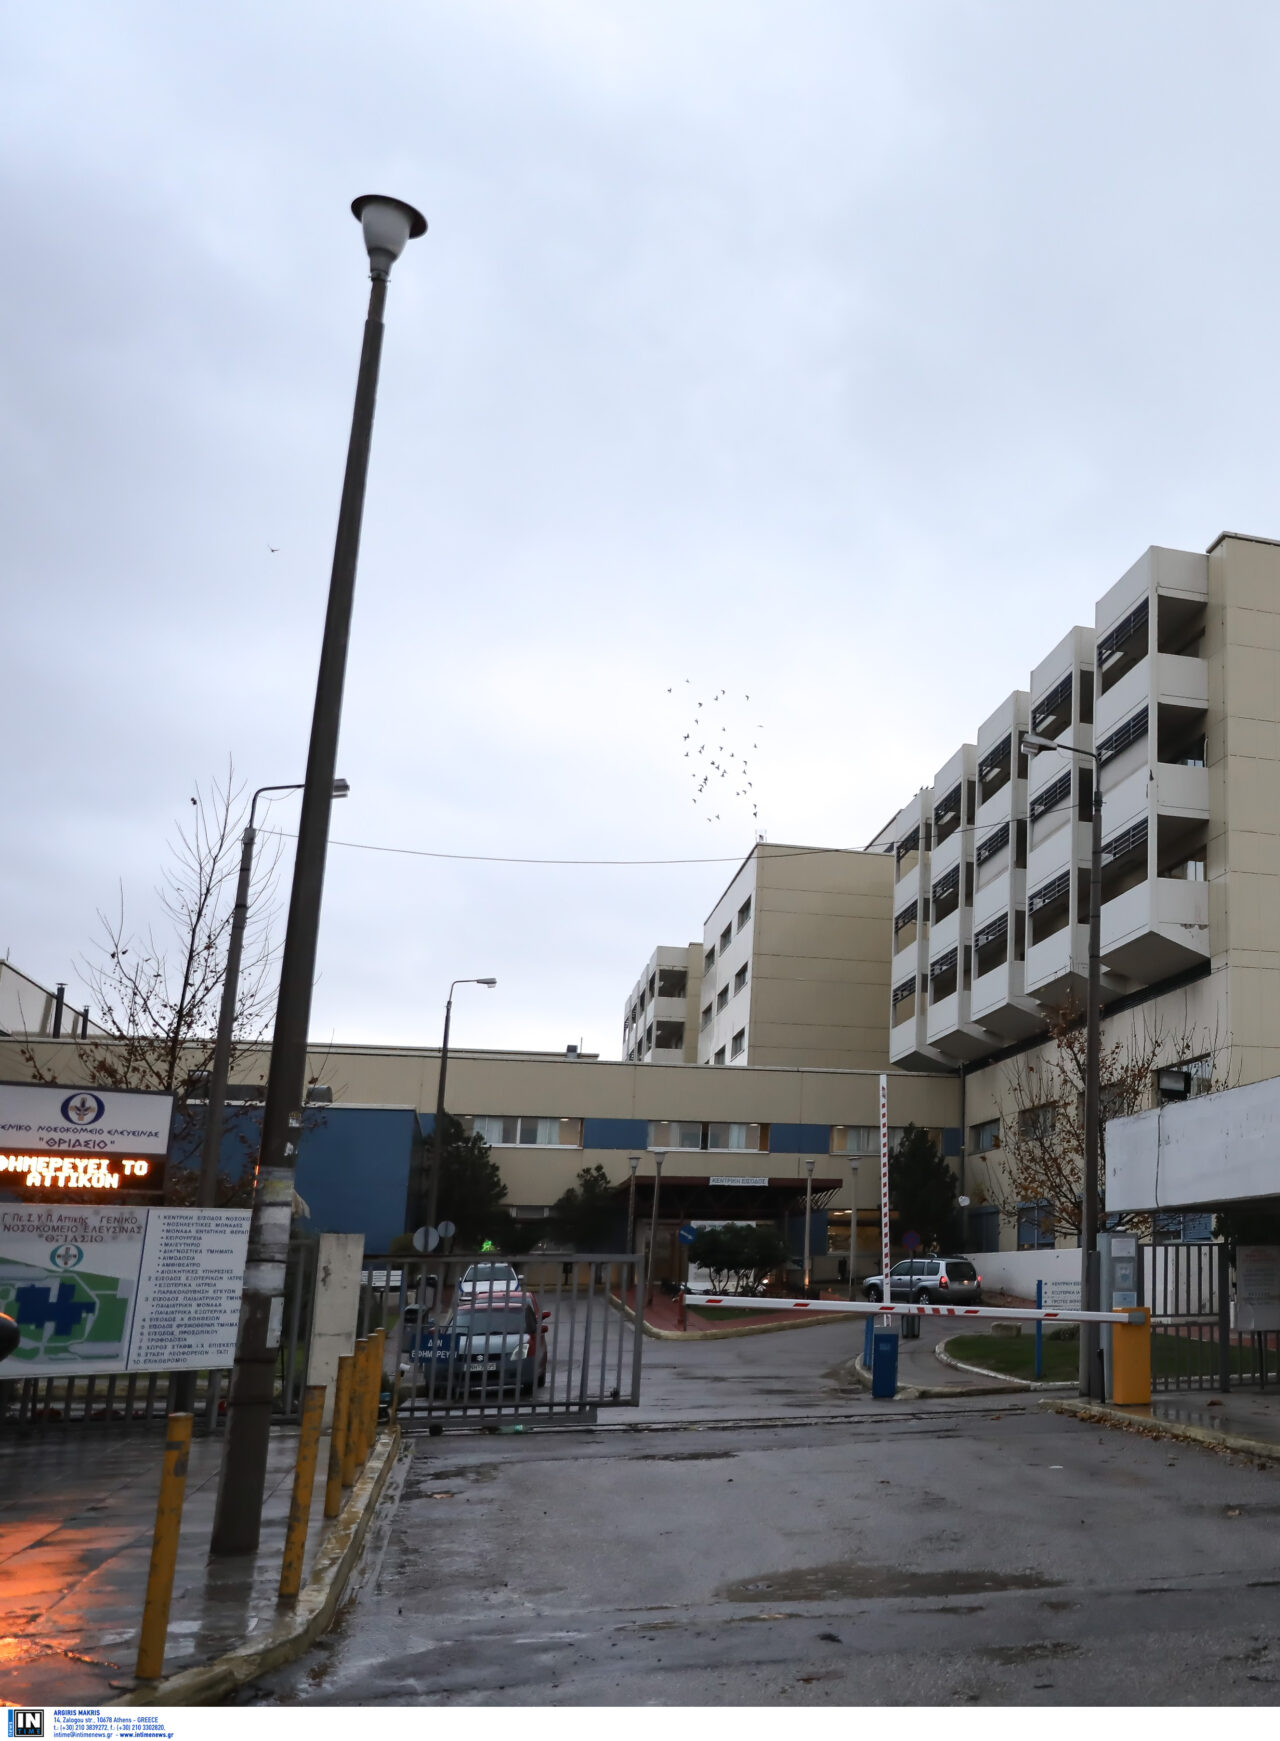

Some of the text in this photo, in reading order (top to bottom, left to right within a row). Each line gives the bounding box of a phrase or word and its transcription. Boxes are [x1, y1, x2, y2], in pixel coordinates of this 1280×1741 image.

[37, 1125, 104, 1135] ΝΟΣΟΚΟΜΕΙΟ
[107, 1128, 160, 1138] ΕΛΕΥΣΙΝΑΣ
[122, 1160, 149, 1176] ΤΟ
[26, 1172, 119, 1189] ΑΤΤΙΚΟΝ
[100, 1216, 138, 1225] ΓΕΝΙΚΟ
[3, 1224, 143, 1234] ΝΟΣΟΚΟΜΕΙΟ ΕΛΕΥΣΙΝΑΣ
[427, 1339, 443, 1347] ΔΝ
